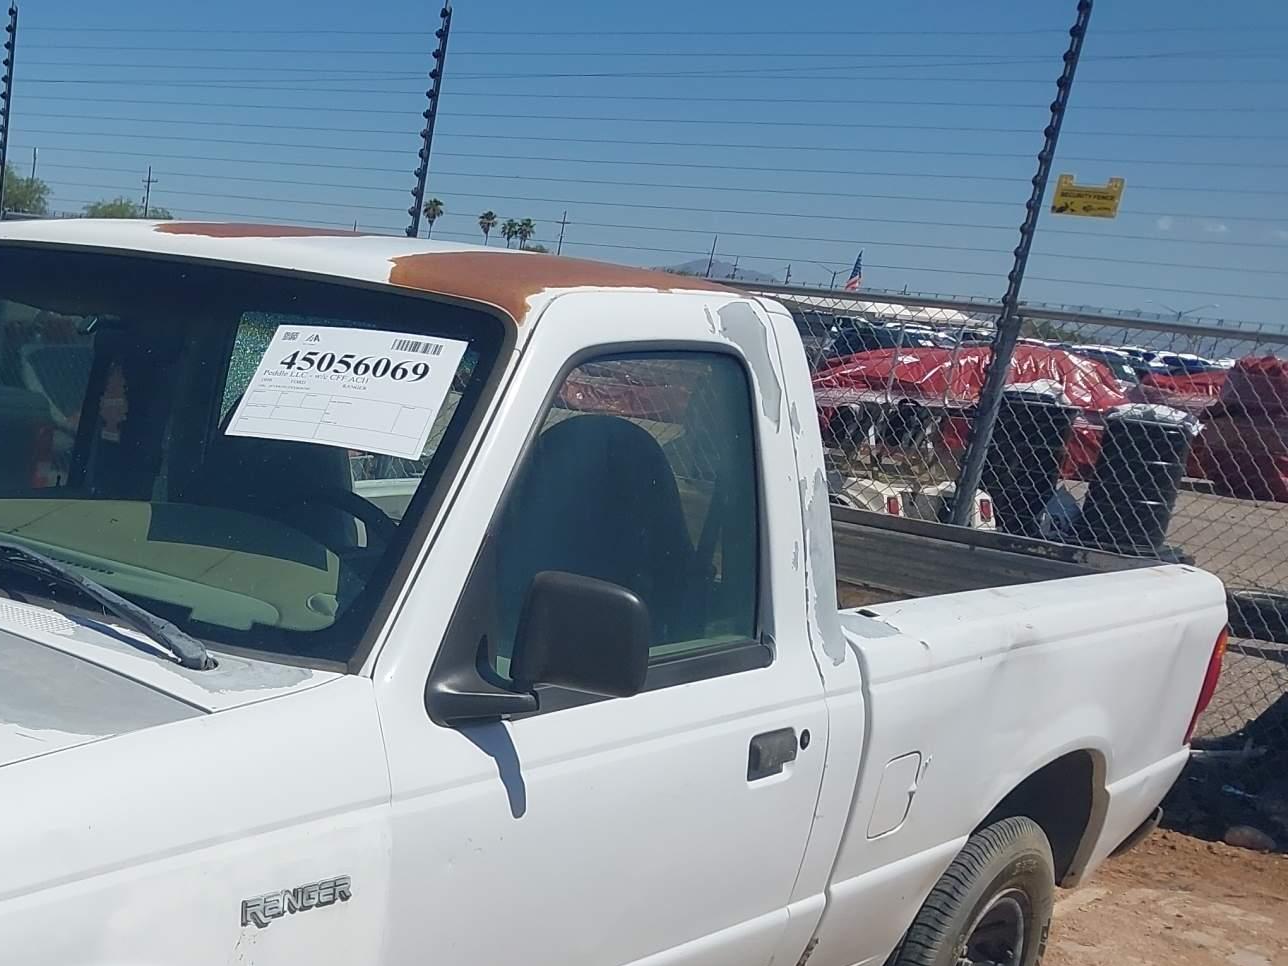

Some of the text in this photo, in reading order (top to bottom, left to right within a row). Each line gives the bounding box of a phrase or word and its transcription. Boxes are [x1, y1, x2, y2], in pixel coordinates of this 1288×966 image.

[279, 350, 430, 383] 45056069
[289, 370, 308, 379] LLC
[240, 875, 353, 929] RANGER
